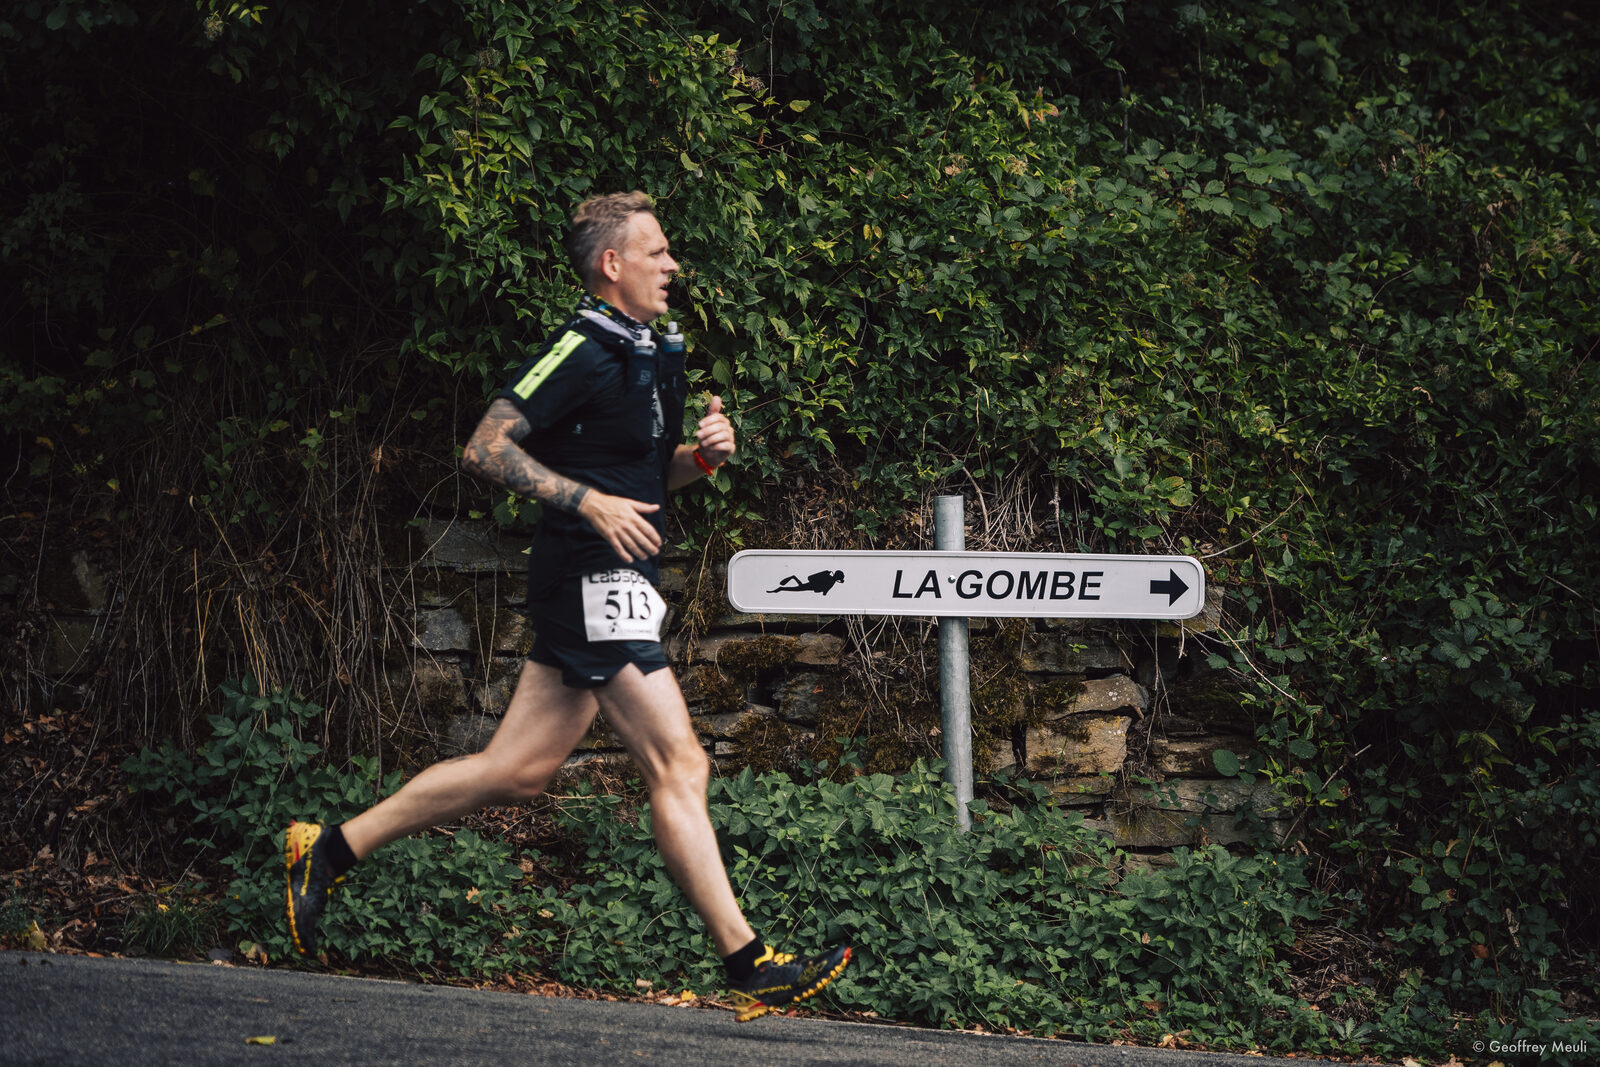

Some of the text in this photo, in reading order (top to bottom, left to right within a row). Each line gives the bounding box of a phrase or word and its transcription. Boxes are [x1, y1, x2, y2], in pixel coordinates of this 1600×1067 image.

[892, 569, 1104, 600] LA GOMBE
[605, 590, 651, 620] 513
